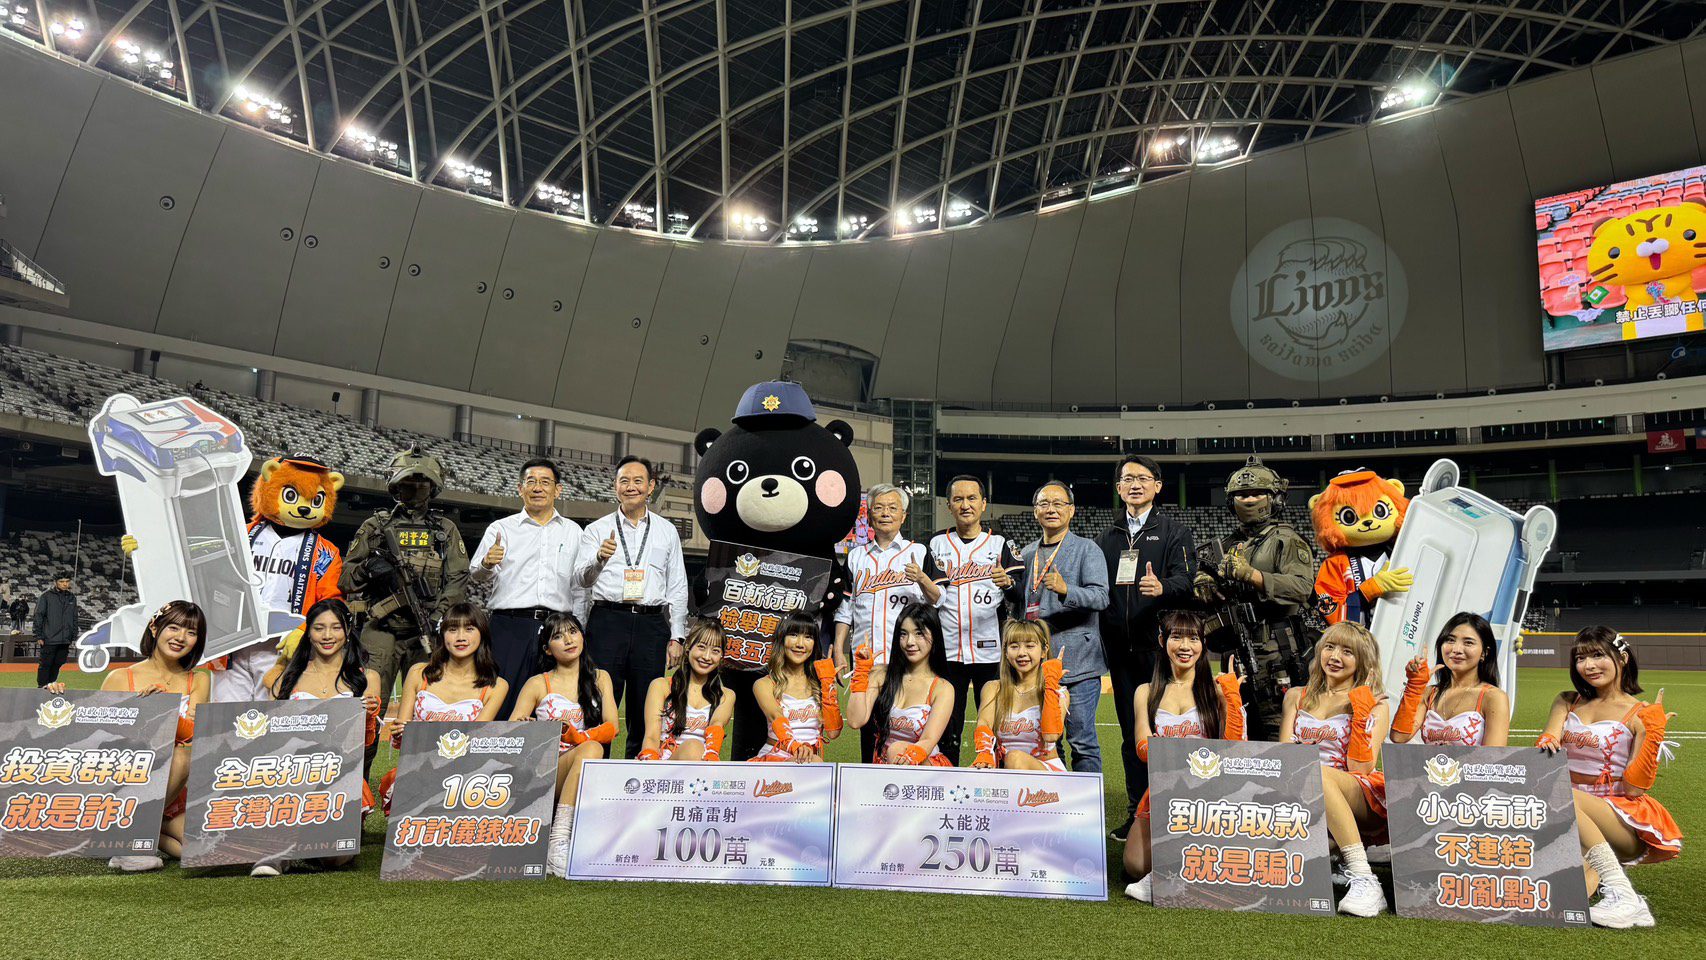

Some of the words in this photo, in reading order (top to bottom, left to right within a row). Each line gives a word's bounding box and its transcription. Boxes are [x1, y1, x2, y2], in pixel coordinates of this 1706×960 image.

[1252, 270, 1385, 322] Lions
[889, 594, 909, 610] 99
[973, 589, 992, 605] 66
[1412, 601, 1425, 625] Talent
[1408, 624, 1418, 640] Pro
[115, 718, 136, 726] Agency
[1, 747, 155, 785] 投資群組
[213, 752, 343, 790] 全民打詐
[443, 774, 513, 809] 165
[642, 779, 684, 795] 愛爾麗
[901, 785, 945, 801] 愛爾麗
[1, 793, 138, 831] 就是詐!
[202, 791, 347, 831] 臺灣尚勇!
[670, 806, 738, 823] 甩痛雷射
[939, 813, 991, 832] 太能波
[1167, 798, 1311, 841] 到府取款
[1417, 792, 1547, 829] 小心有詐
[394, 815, 542, 847] 打詐儀錶板!
[134, 841, 153, 850] 廣告
[338, 841, 355, 850] 廣告
[615, 854, 639, 863] 新台幣
[653, 827, 750, 865] 100萬
[759, 857, 776, 866] 元整
[880, 862, 905, 872] 新台幣
[919, 834, 1020, 876] 250萬
[1030, 869, 1047, 879] 元整
[1435, 833, 1534, 869] 不連結
[525, 866, 542, 874] 廣告
[1180, 843, 1304, 889] 就是騙!
[1312, 901, 1329, 909] 廣告
[1437, 873, 1551, 912] 別亂點!
[1566, 912, 1584, 921] 廣告
